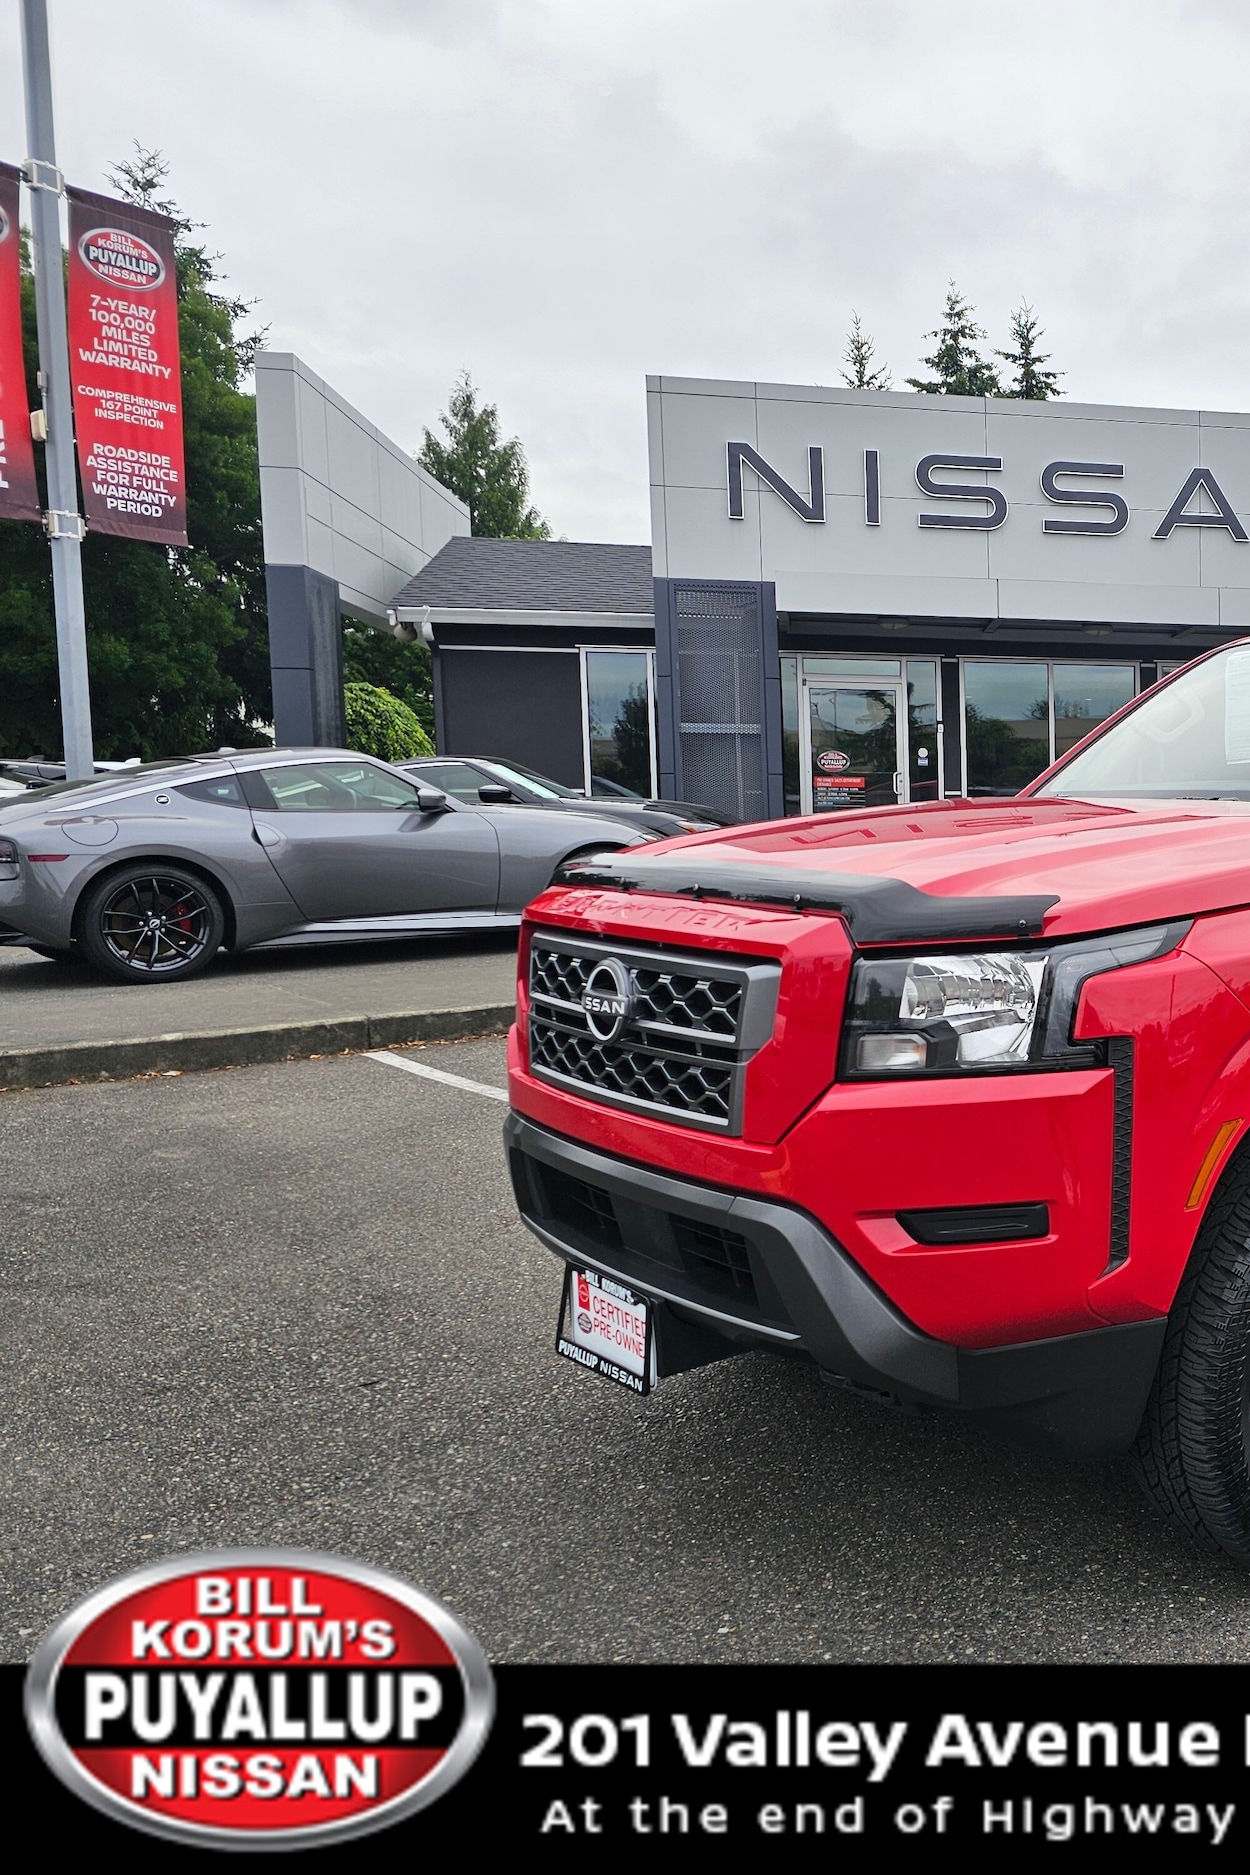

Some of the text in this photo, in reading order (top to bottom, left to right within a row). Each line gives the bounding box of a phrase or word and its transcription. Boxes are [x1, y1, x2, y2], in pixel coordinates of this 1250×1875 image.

[97, 238, 148, 259] KORUM'S
[110, 232, 134, 247] BILL
[89, 245, 157, 276] PUYALLUP
[98, 264, 147, 284] NISSAN
[90, 294, 156, 321] 7-YEAR/
[89, 309, 156, 335] 100,000
[101, 325, 151, 347] MILES
[93, 337, 158, 362] LIMITED
[79, 348, 171, 379] WARRANTY
[77, 385, 177, 413] COMPREHENSIVE
[100, 399, 158, 418] 167 POINT
[94, 408, 164, 430] INSPECTION
[93, 442, 171, 468] ROADSIDE
[86, 455, 178, 482] ASSISTANCE
[96, 469, 168, 493] FOR FULL
[92, 482, 176, 507] WARRANTY
[106, 497, 163, 518] PERIOD
[585, 996, 625, 1015] SSAN
[585, 1269, 635, 1305] BILL KORUM'S
[593, 1317, 645, 1359] PRE-OWNE
[558, 1339, 643, 1392] PUYALLUP NISSAN
